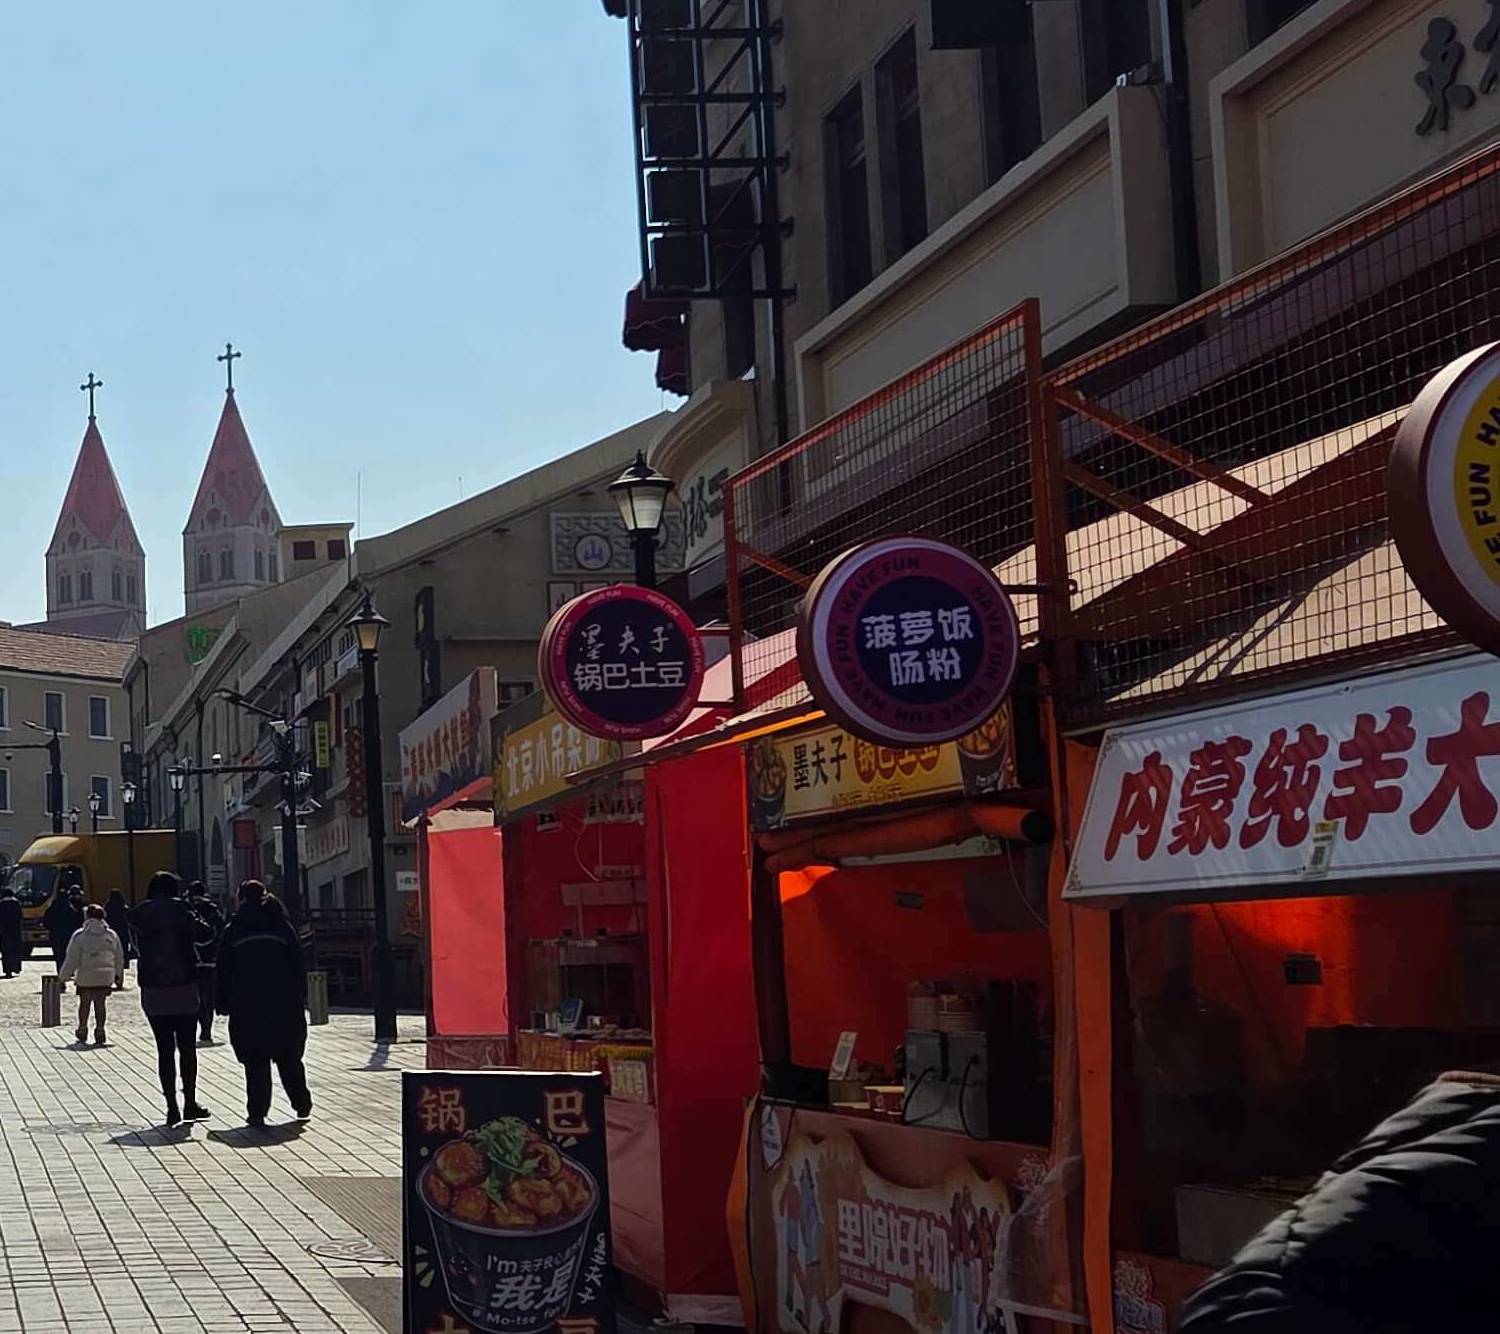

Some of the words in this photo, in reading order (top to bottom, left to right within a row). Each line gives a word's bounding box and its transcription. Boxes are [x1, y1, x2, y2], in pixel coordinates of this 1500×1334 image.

[1470, 463, 1497, 526] FUN
[841, 569, 879, 612] HAVE
[882, 556, 920, 575] FUN
[835, 624, 850, 662] FUN
[861, 605, 974, 650] 菠萝饭
[573, 660, 687, 692] 锅巴土豆
[888, 646, 962, 686] 肠粉
[793, 734, 847, 791] 墨夫子
[1104, 691, 1500, 862] 内蒙纯羊大
[420, 1087, 466, 1133] 锅
[544, 1089, 591, 1135] 巴
